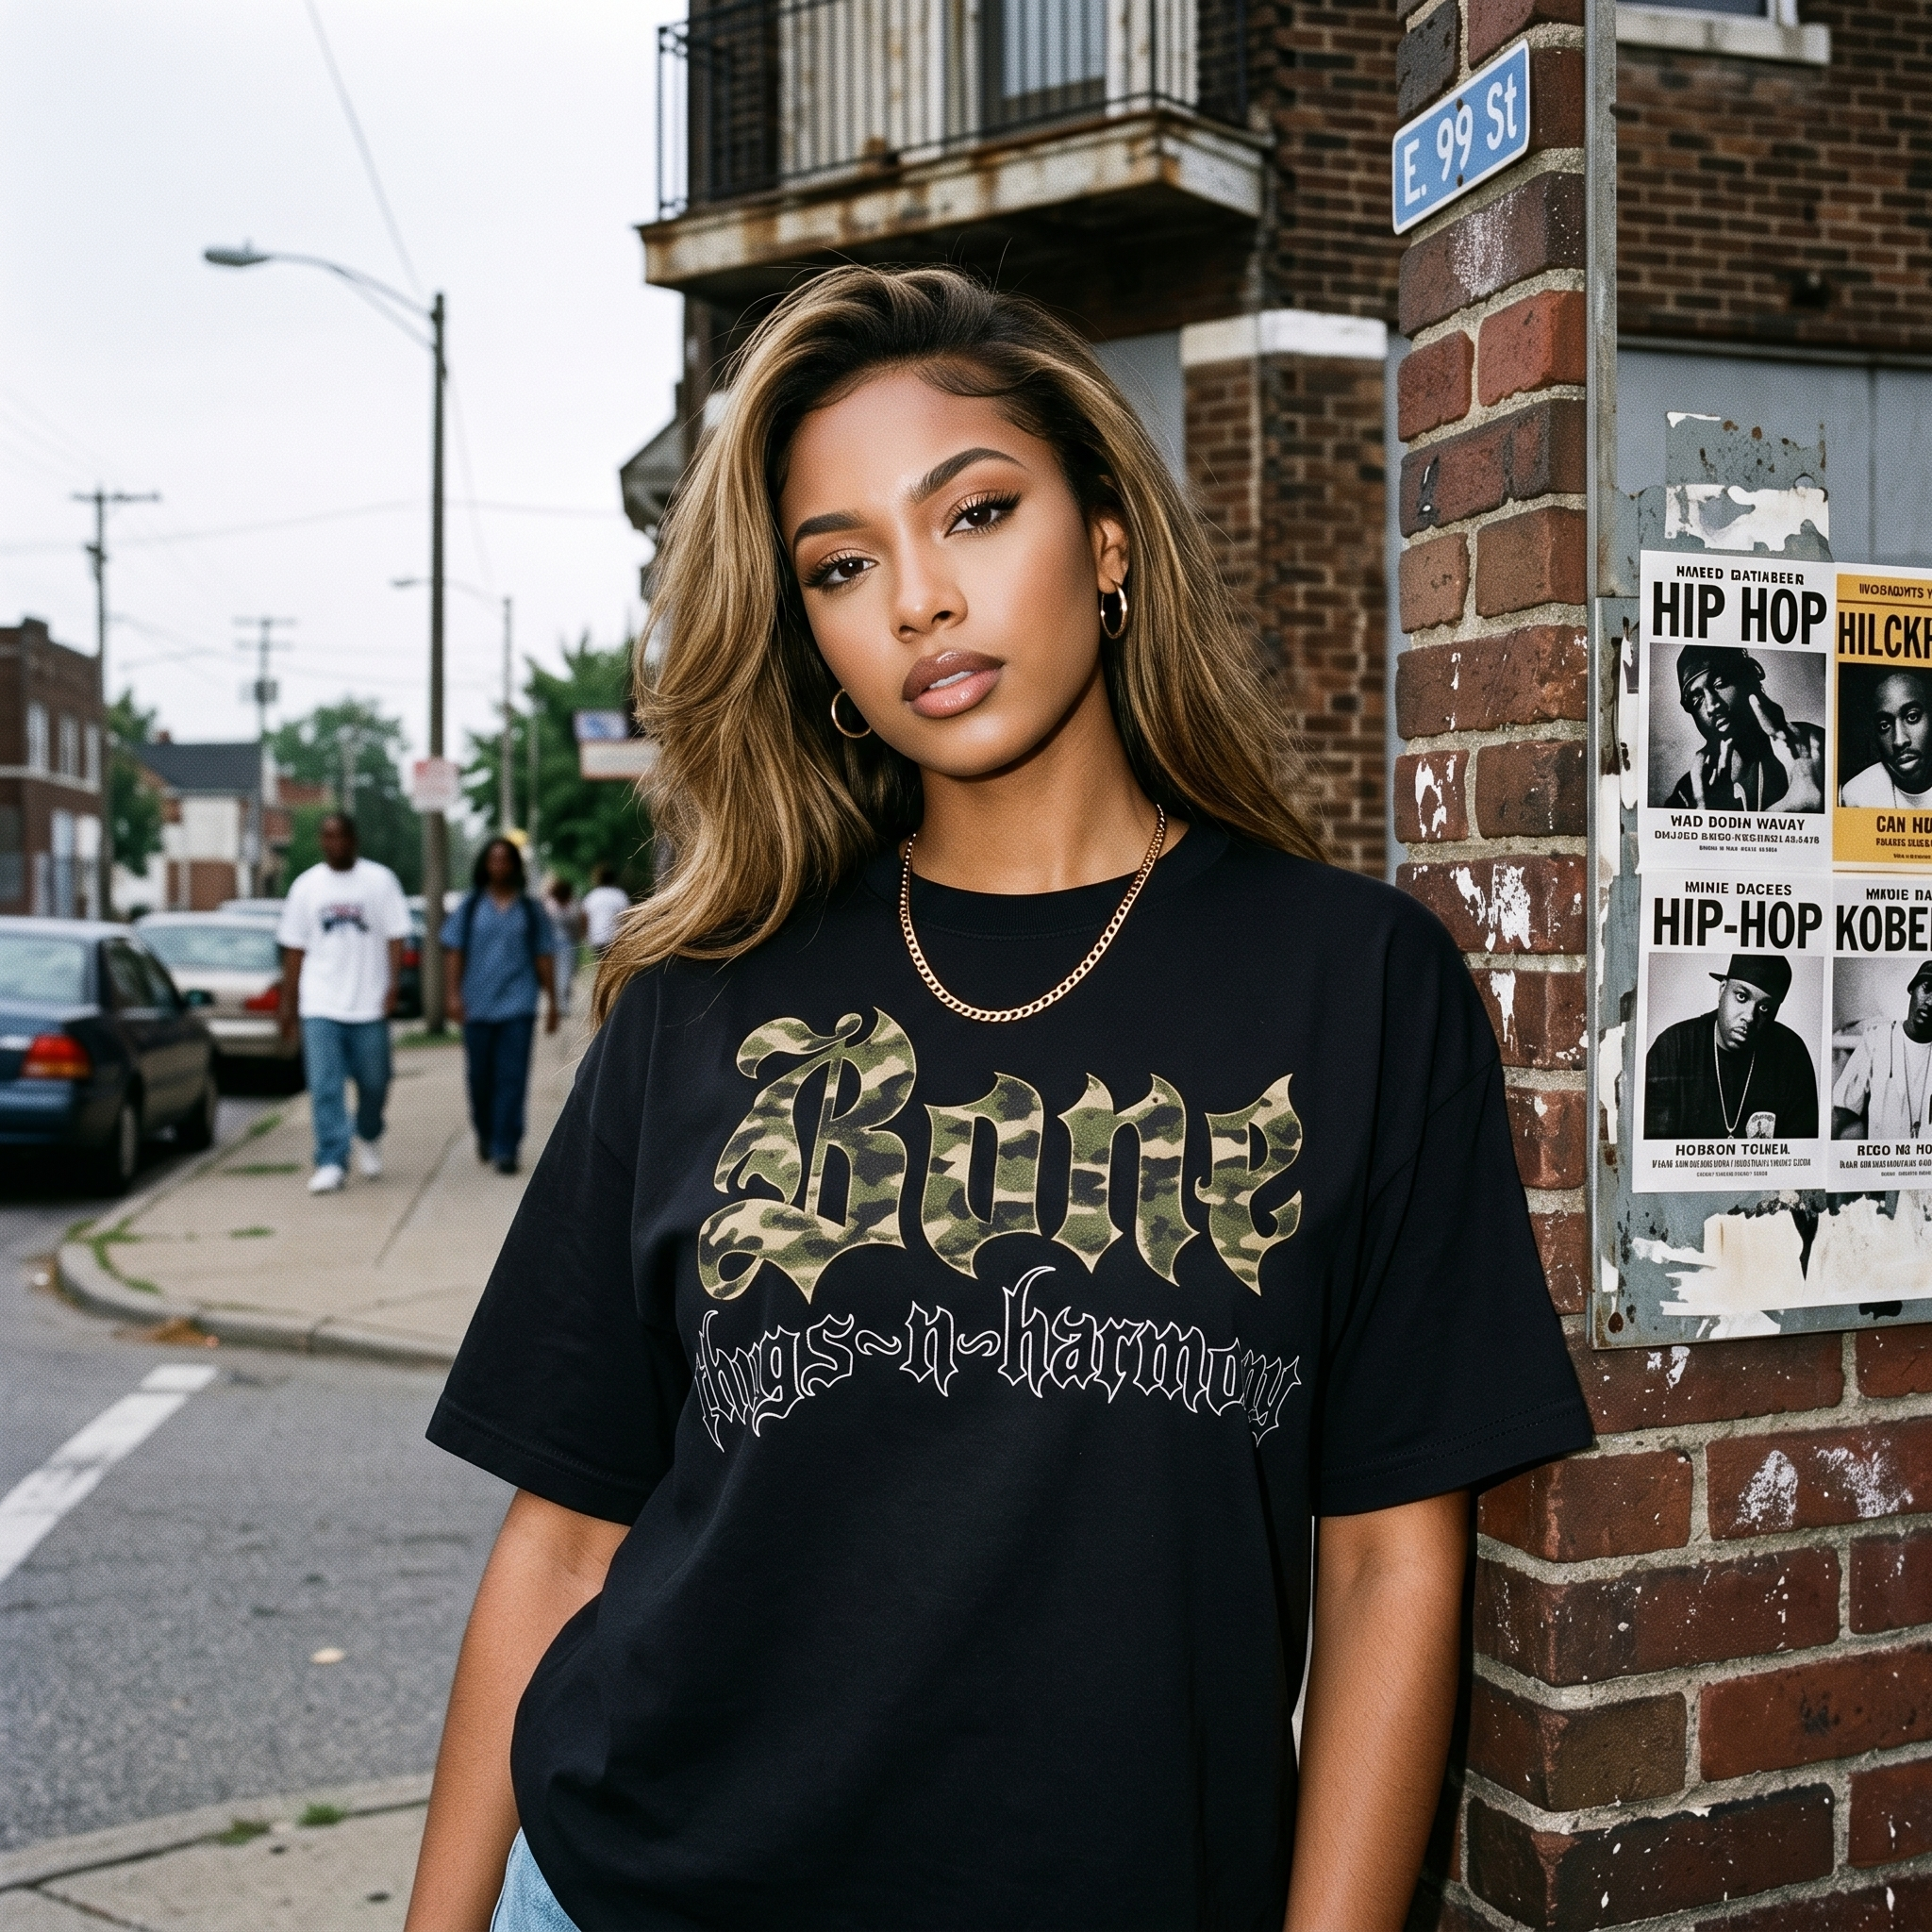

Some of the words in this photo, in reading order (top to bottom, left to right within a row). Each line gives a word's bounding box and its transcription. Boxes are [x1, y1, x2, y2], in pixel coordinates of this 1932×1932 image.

[1404, 138, 1427, 207] E.
[1437, 104, 1474, 182] 99
[1486, 72, 1518, 151] St
[1652, 581, 1725, 639] HIP
[1740, 586, 1827, 645] HOP
[1876, 815, 1906, 833] CAN
[1736, 882, 1792, 896] DACEES
[1653, 897, 1823, 949] HIP-HOP
[1836, 904, 1932, 953] KOBE
[698, 1006, 1303, 1305] Bone
